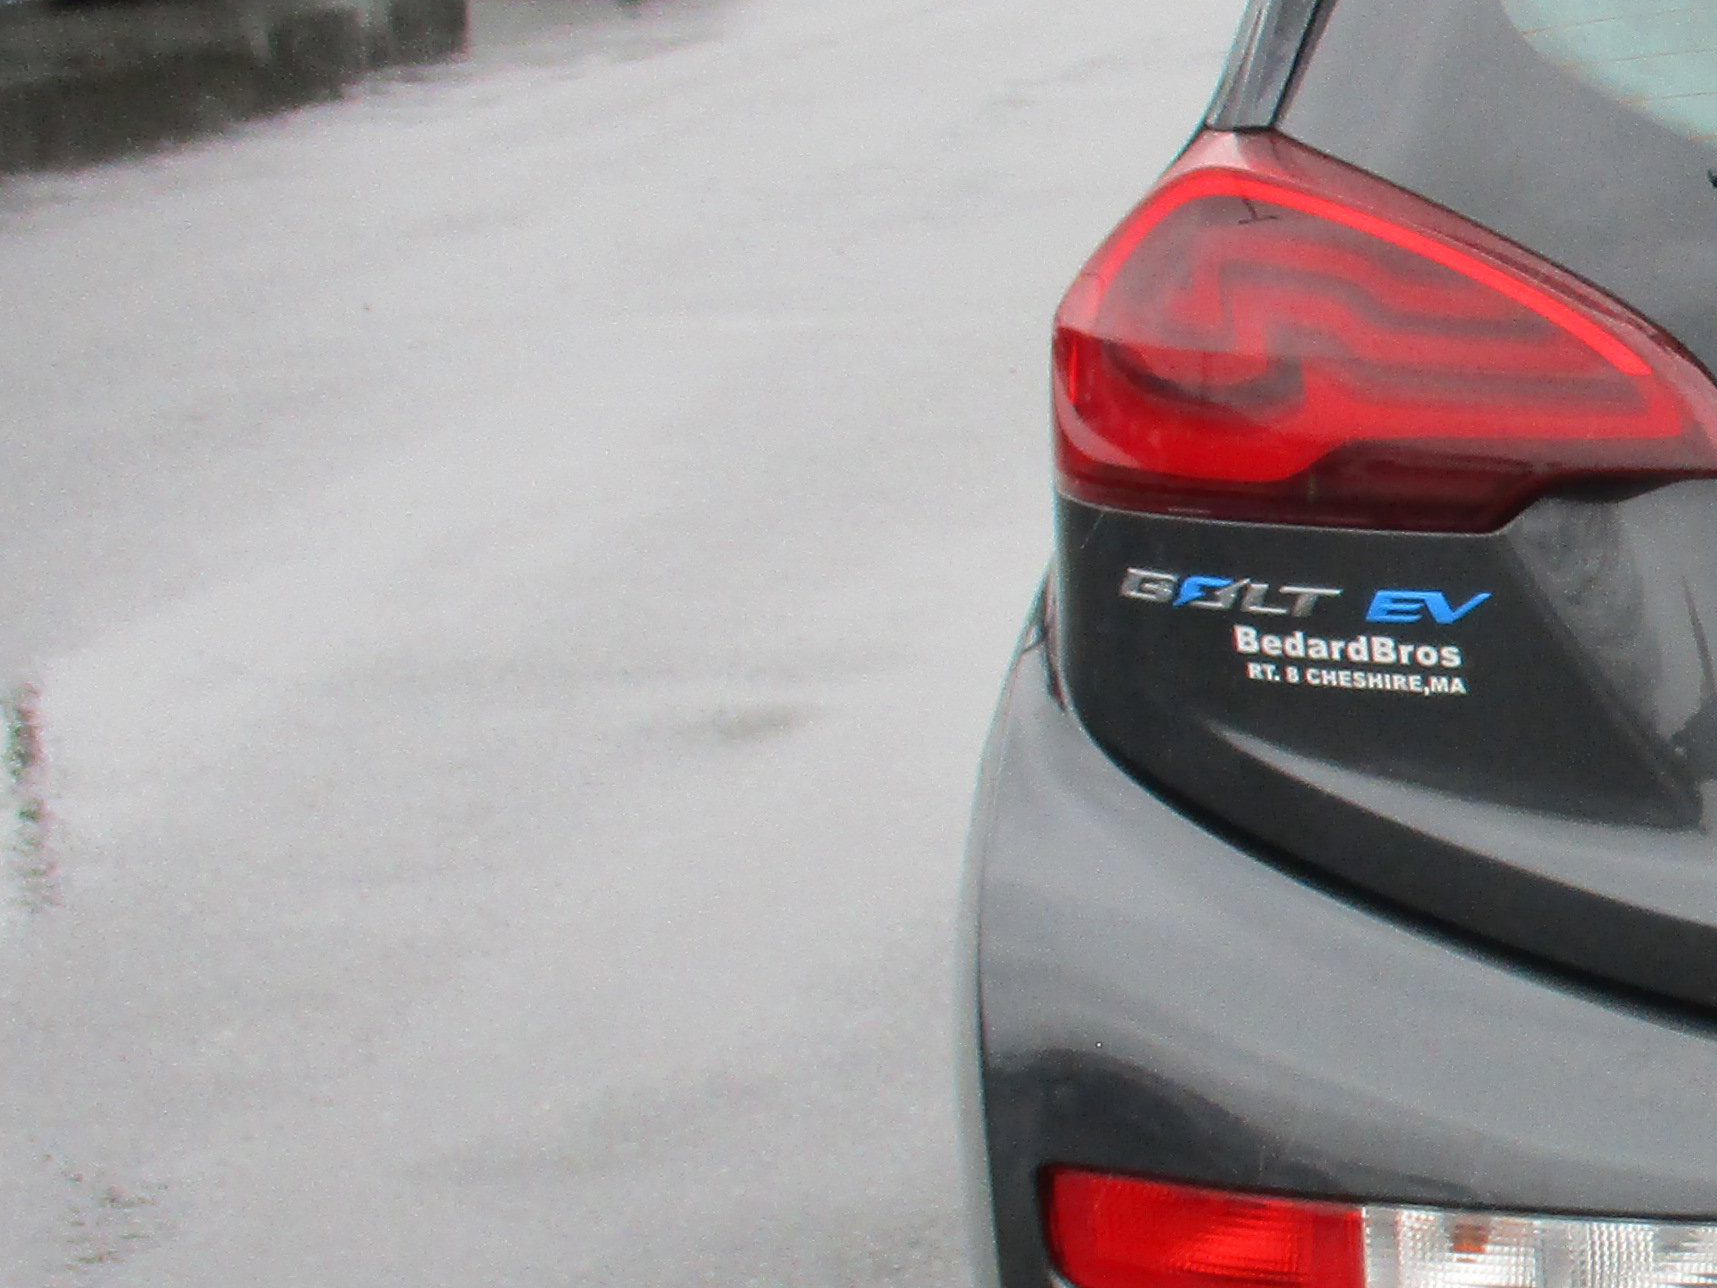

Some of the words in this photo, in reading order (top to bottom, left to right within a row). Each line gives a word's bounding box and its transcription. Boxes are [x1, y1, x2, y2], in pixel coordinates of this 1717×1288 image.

[1118, 567, 1344, 618] BOLT
[1365, 589, 1493, 624] EV
[1233, 624, 1463, 668] BedardBros
[1246, 662, 1281, 682] RT.
